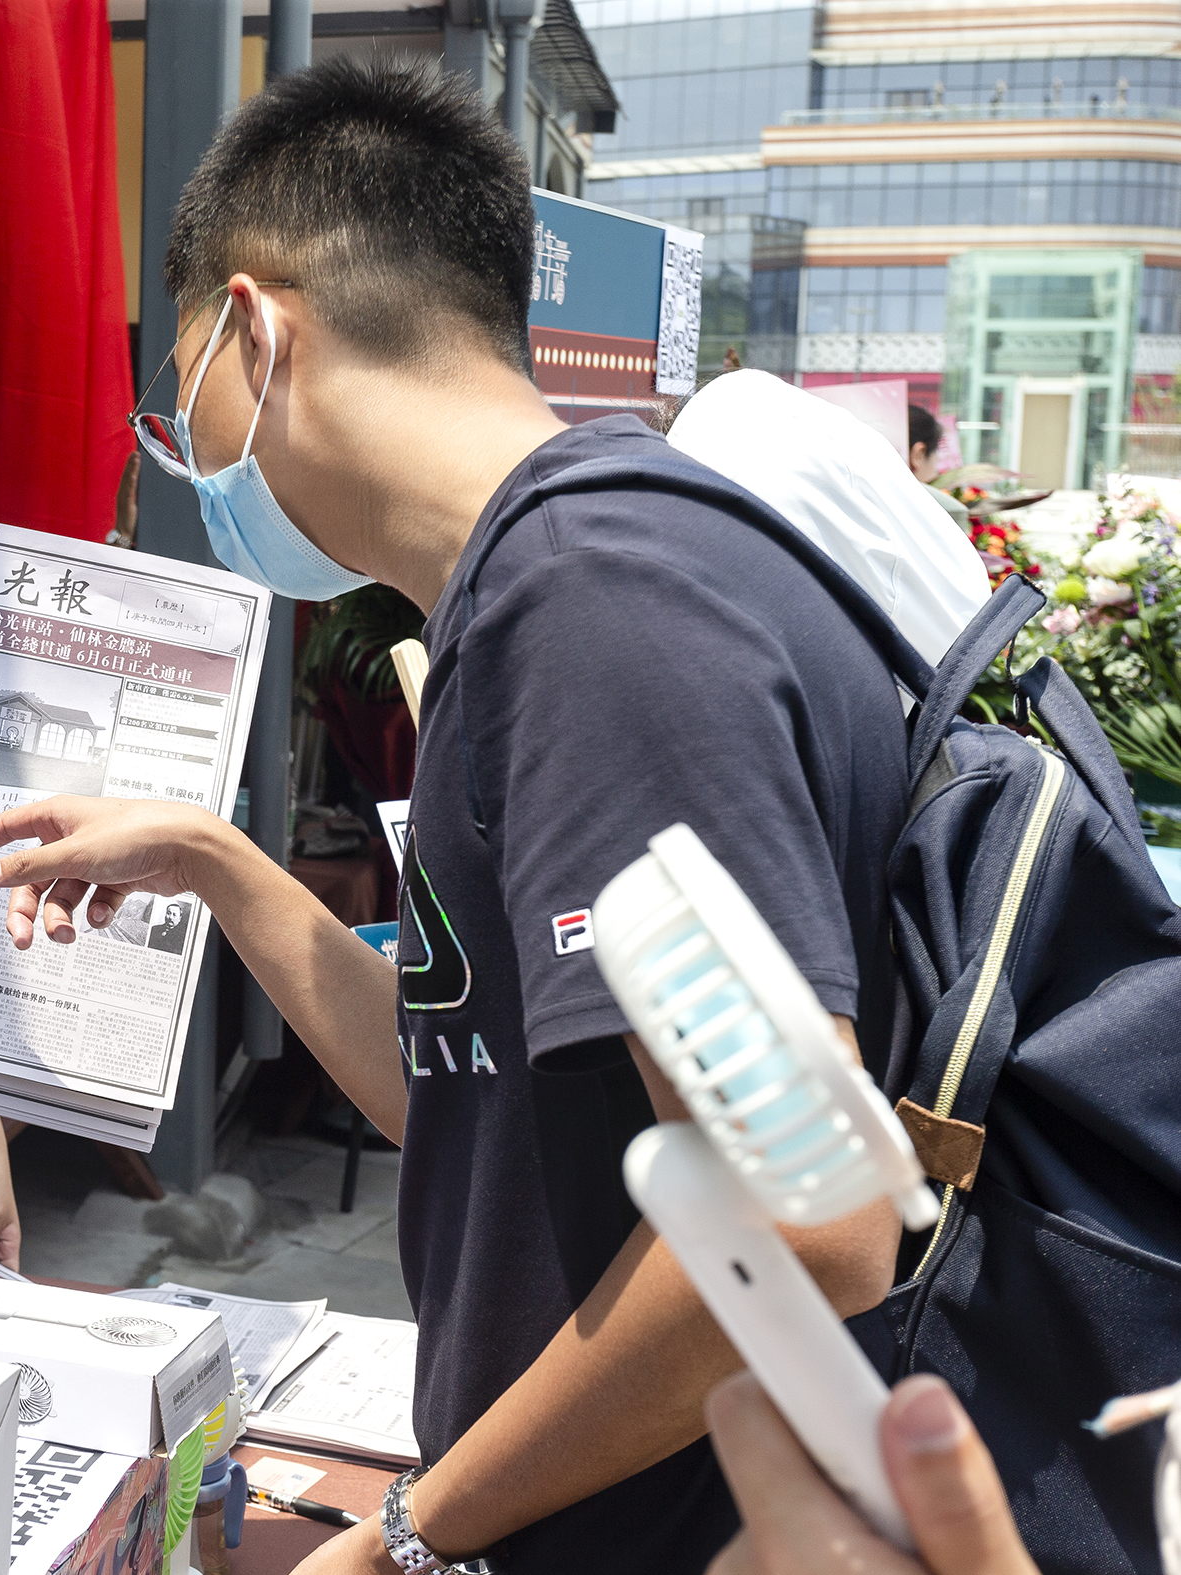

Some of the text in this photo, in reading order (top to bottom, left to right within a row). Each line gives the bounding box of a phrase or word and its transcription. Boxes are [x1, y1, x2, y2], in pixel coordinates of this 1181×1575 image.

[76, 649, 193, 685] 6月6日正式通車
[398, 1033, 499, 1077] LIA
